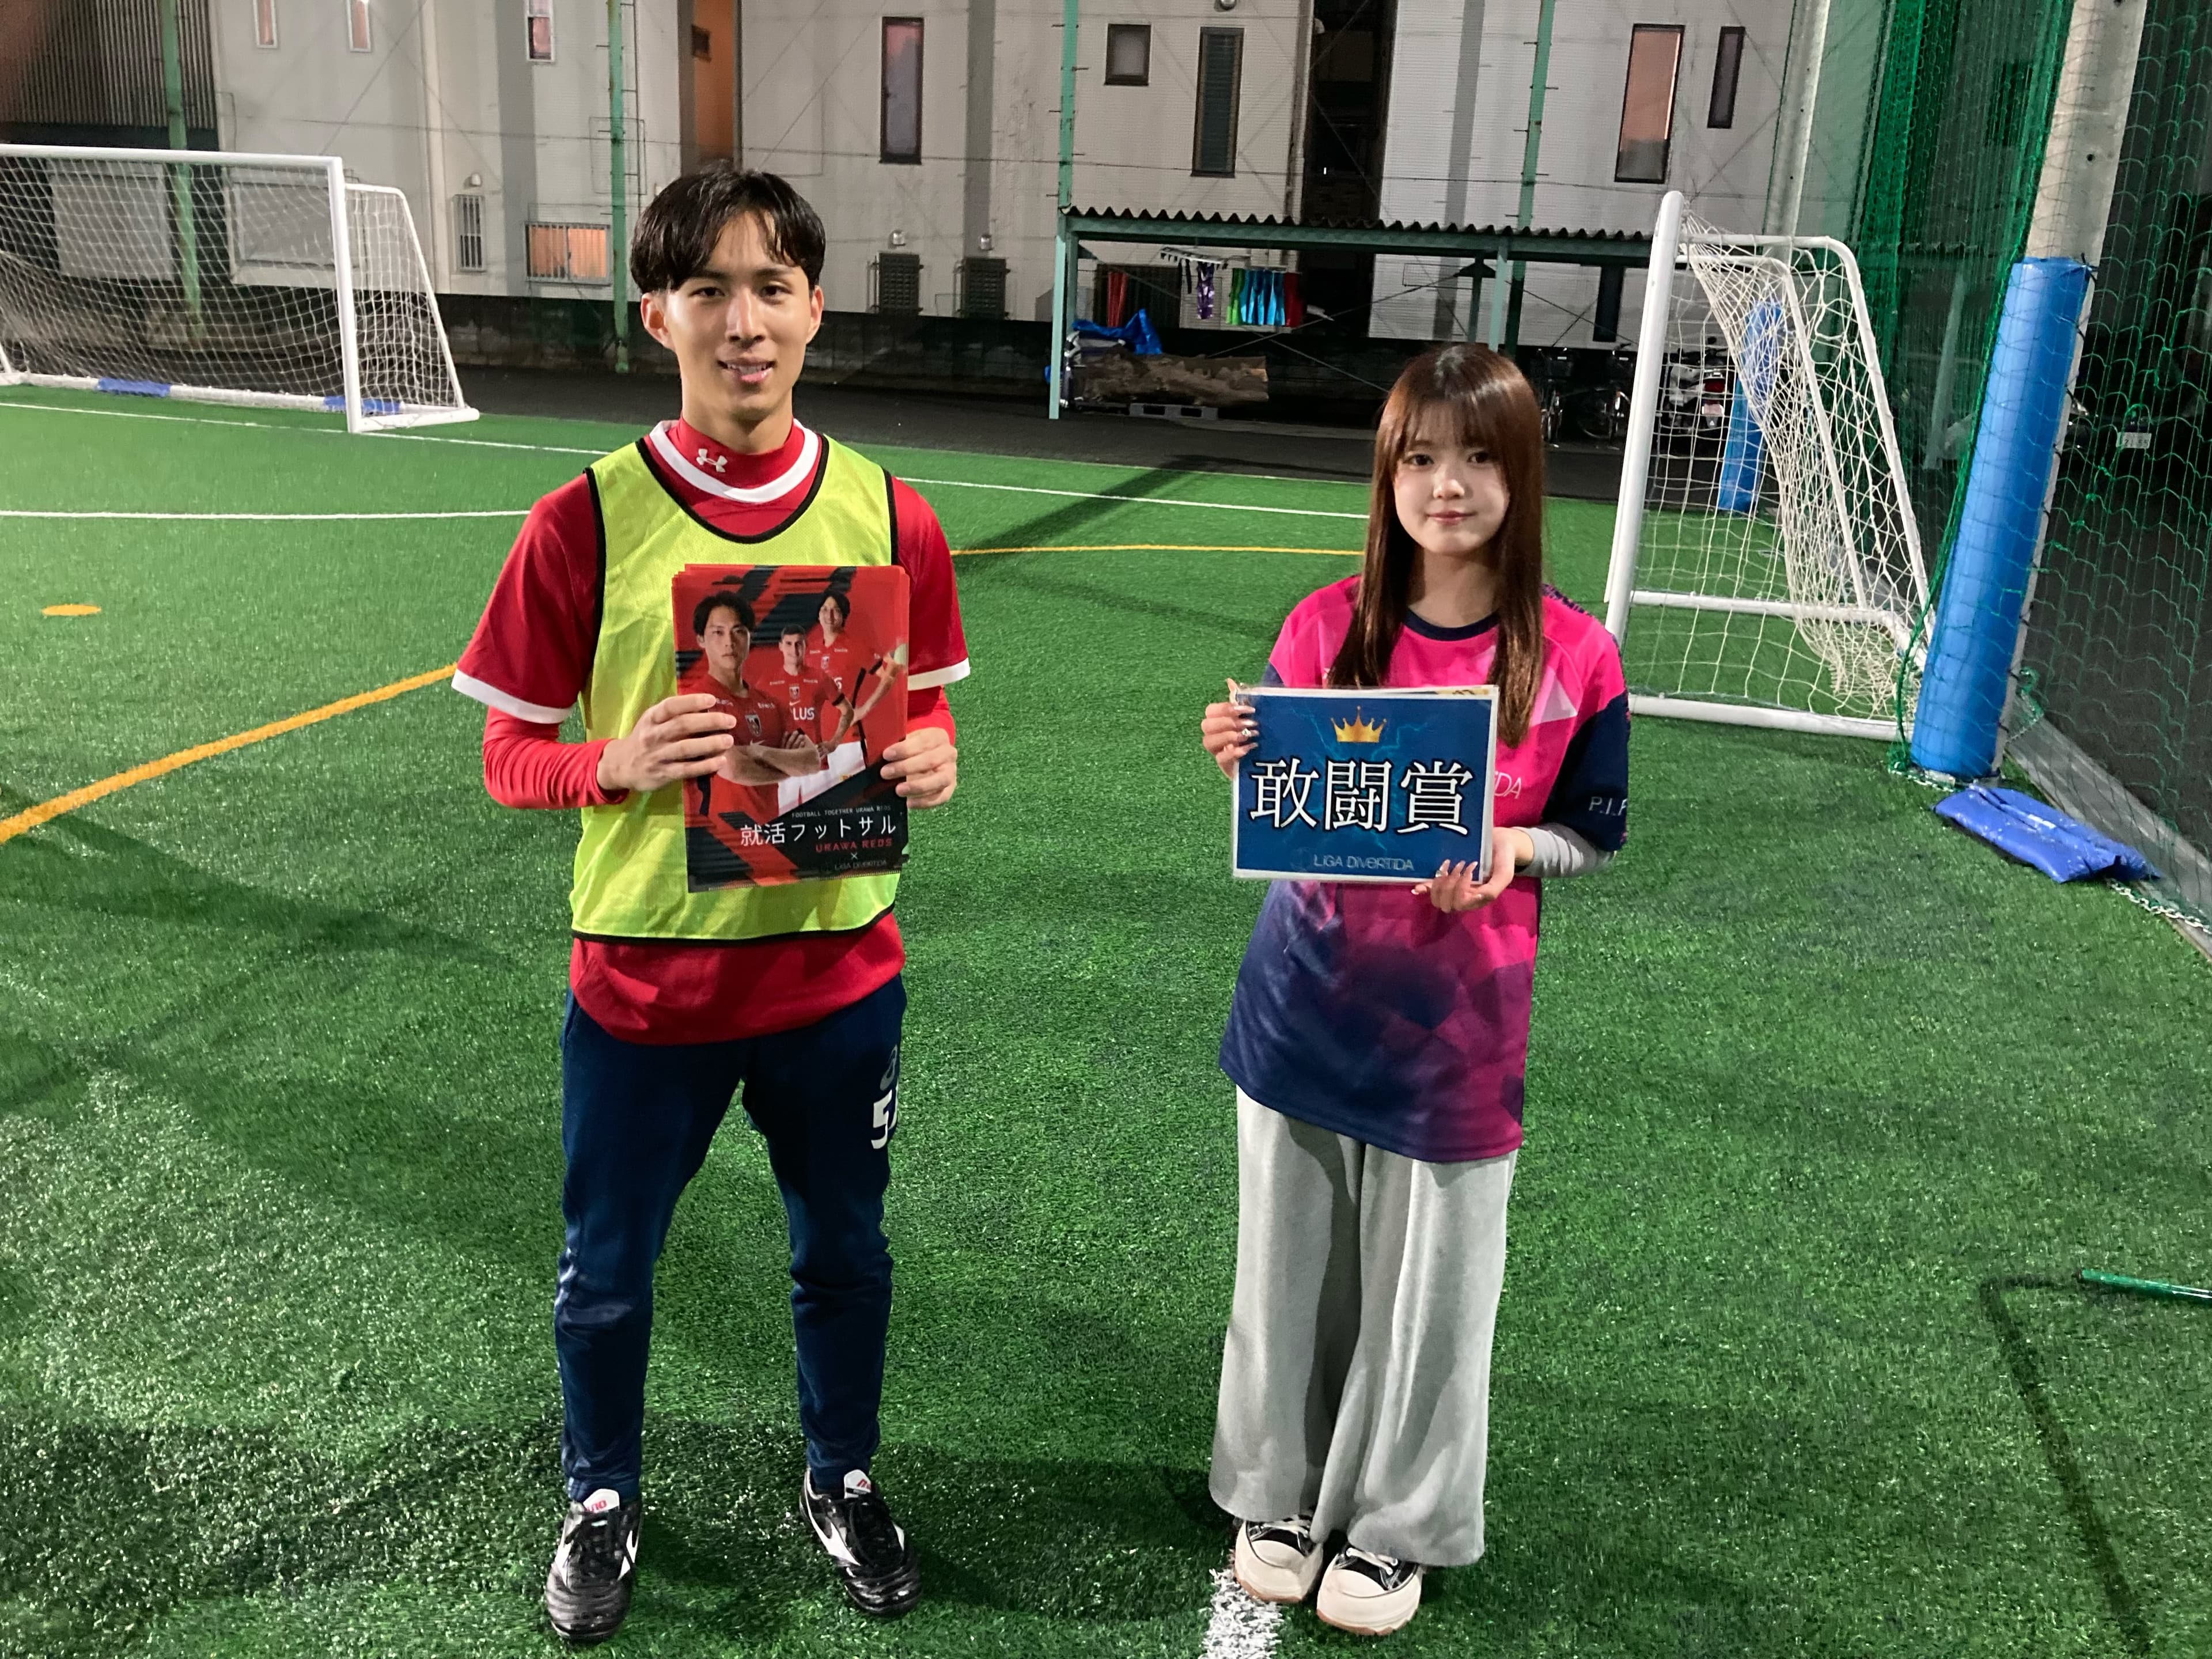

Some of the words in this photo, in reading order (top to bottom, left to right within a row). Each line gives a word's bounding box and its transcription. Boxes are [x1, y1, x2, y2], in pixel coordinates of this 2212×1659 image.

[791, 707, 815, 721] LUS
[1249, 756, 1474, 836] 敢闘賞
[1494, 771, 1522, 800] DA
[824, 807, 853, 816] TOGETHER
[740, 815, 896, 847] 就活フットサル
[815, 841, 857, 853] URAWA
[862, 838, 892, 849] REDS
[870, 1077, 899, 1149] 5
